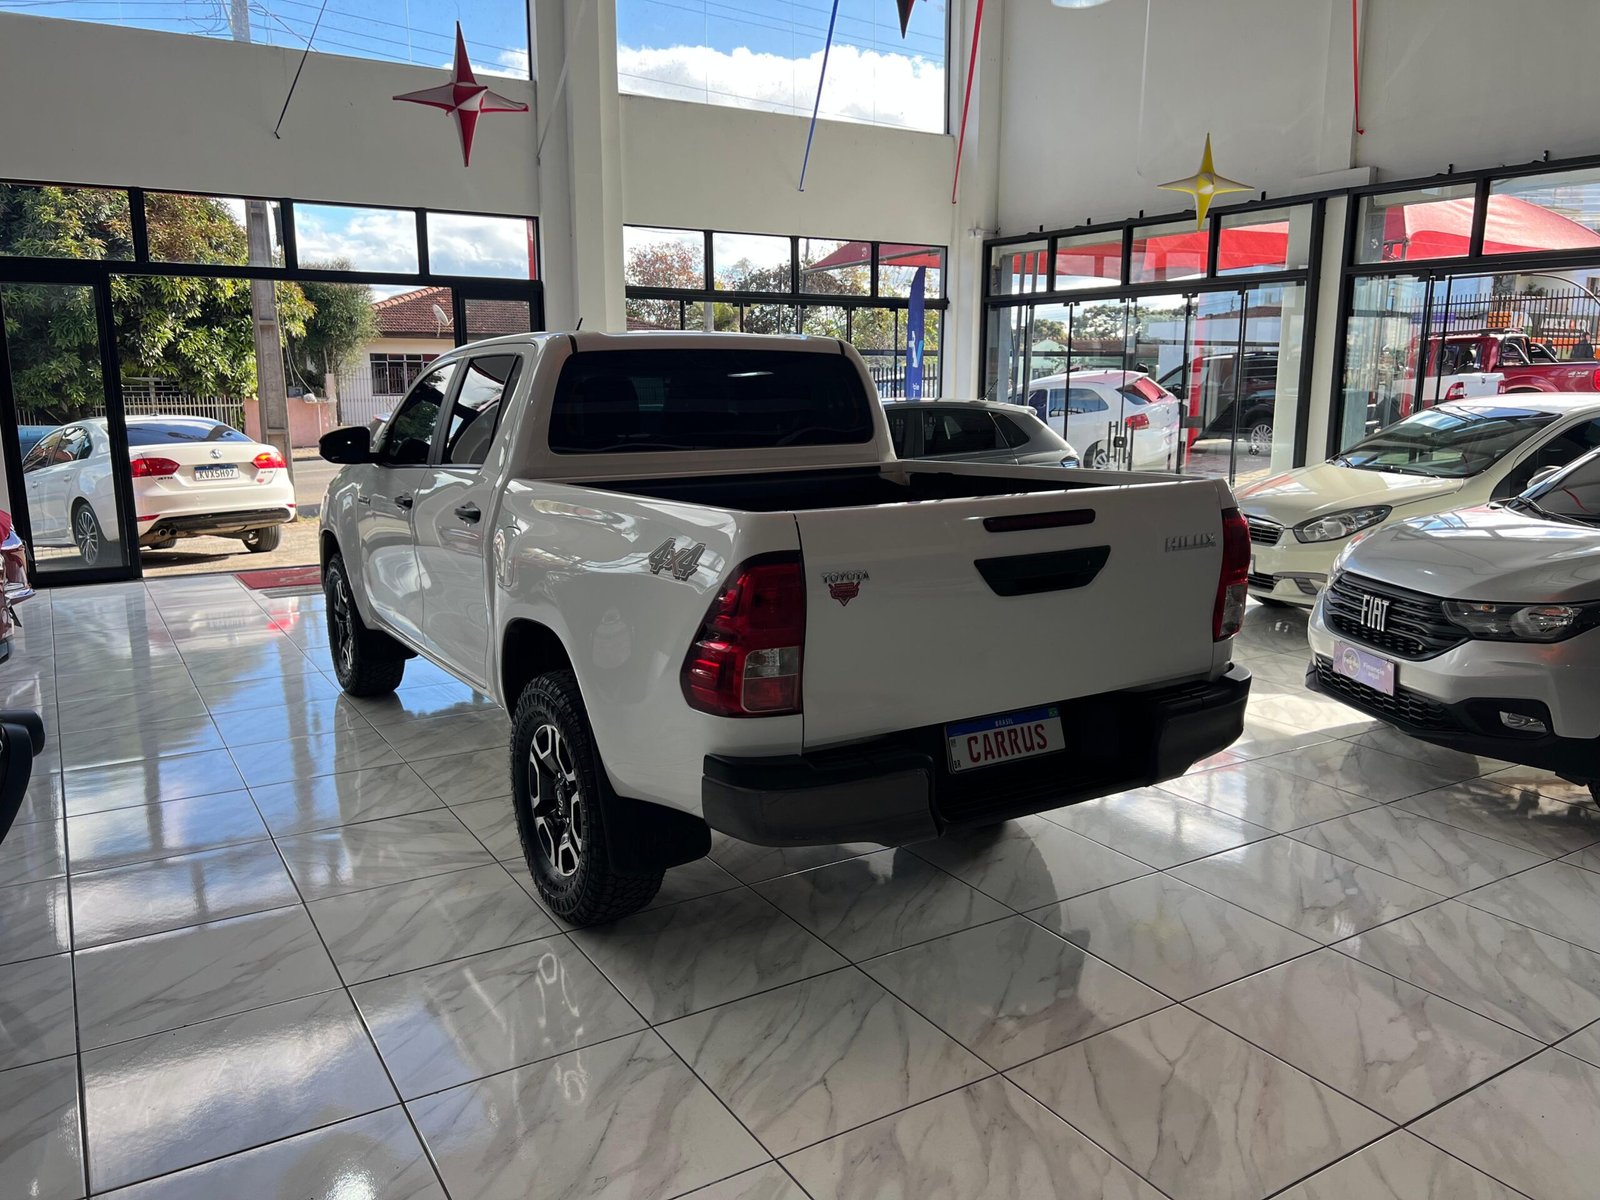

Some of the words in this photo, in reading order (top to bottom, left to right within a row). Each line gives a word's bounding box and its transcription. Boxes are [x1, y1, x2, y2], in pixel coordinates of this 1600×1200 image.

[1165, 533, 1216, 552] HILUX
[822, 571, 870, 583] TOYOTA
[1361, 595, 1391, 632] FIAT
[995, 718, 1014, 727] BRASIL
[967, 723, 1048, 763] CARRUS
